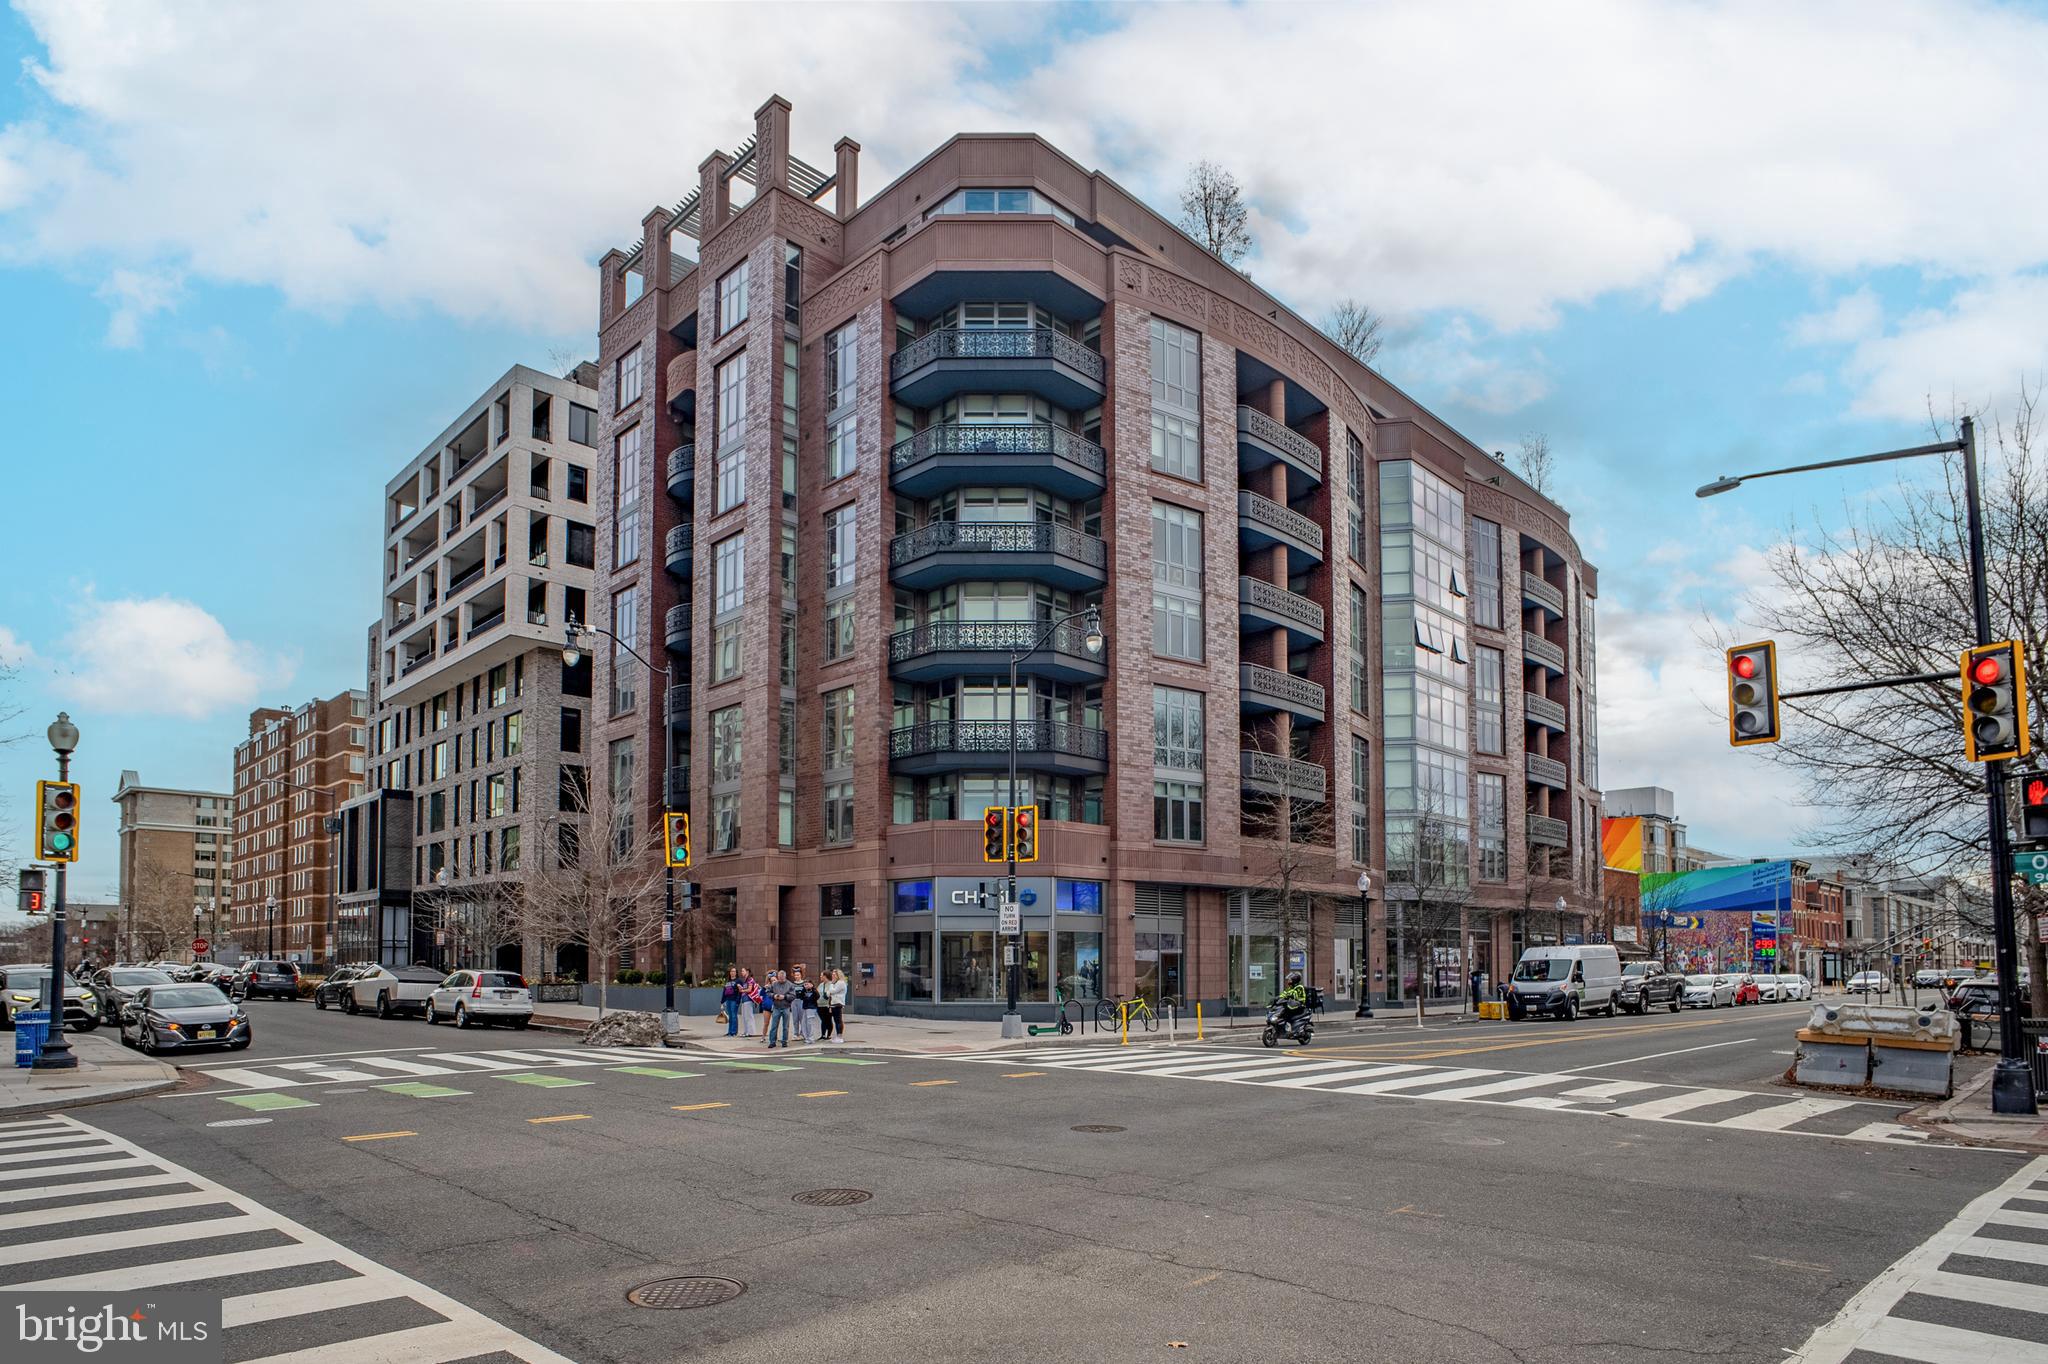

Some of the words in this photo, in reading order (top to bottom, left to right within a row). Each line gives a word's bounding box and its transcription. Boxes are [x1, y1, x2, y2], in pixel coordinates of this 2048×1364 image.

[2034, 872, 2048, 882] 9
[31, 892, 41, 909] 3
[192, 942, 208, 950] STOP
